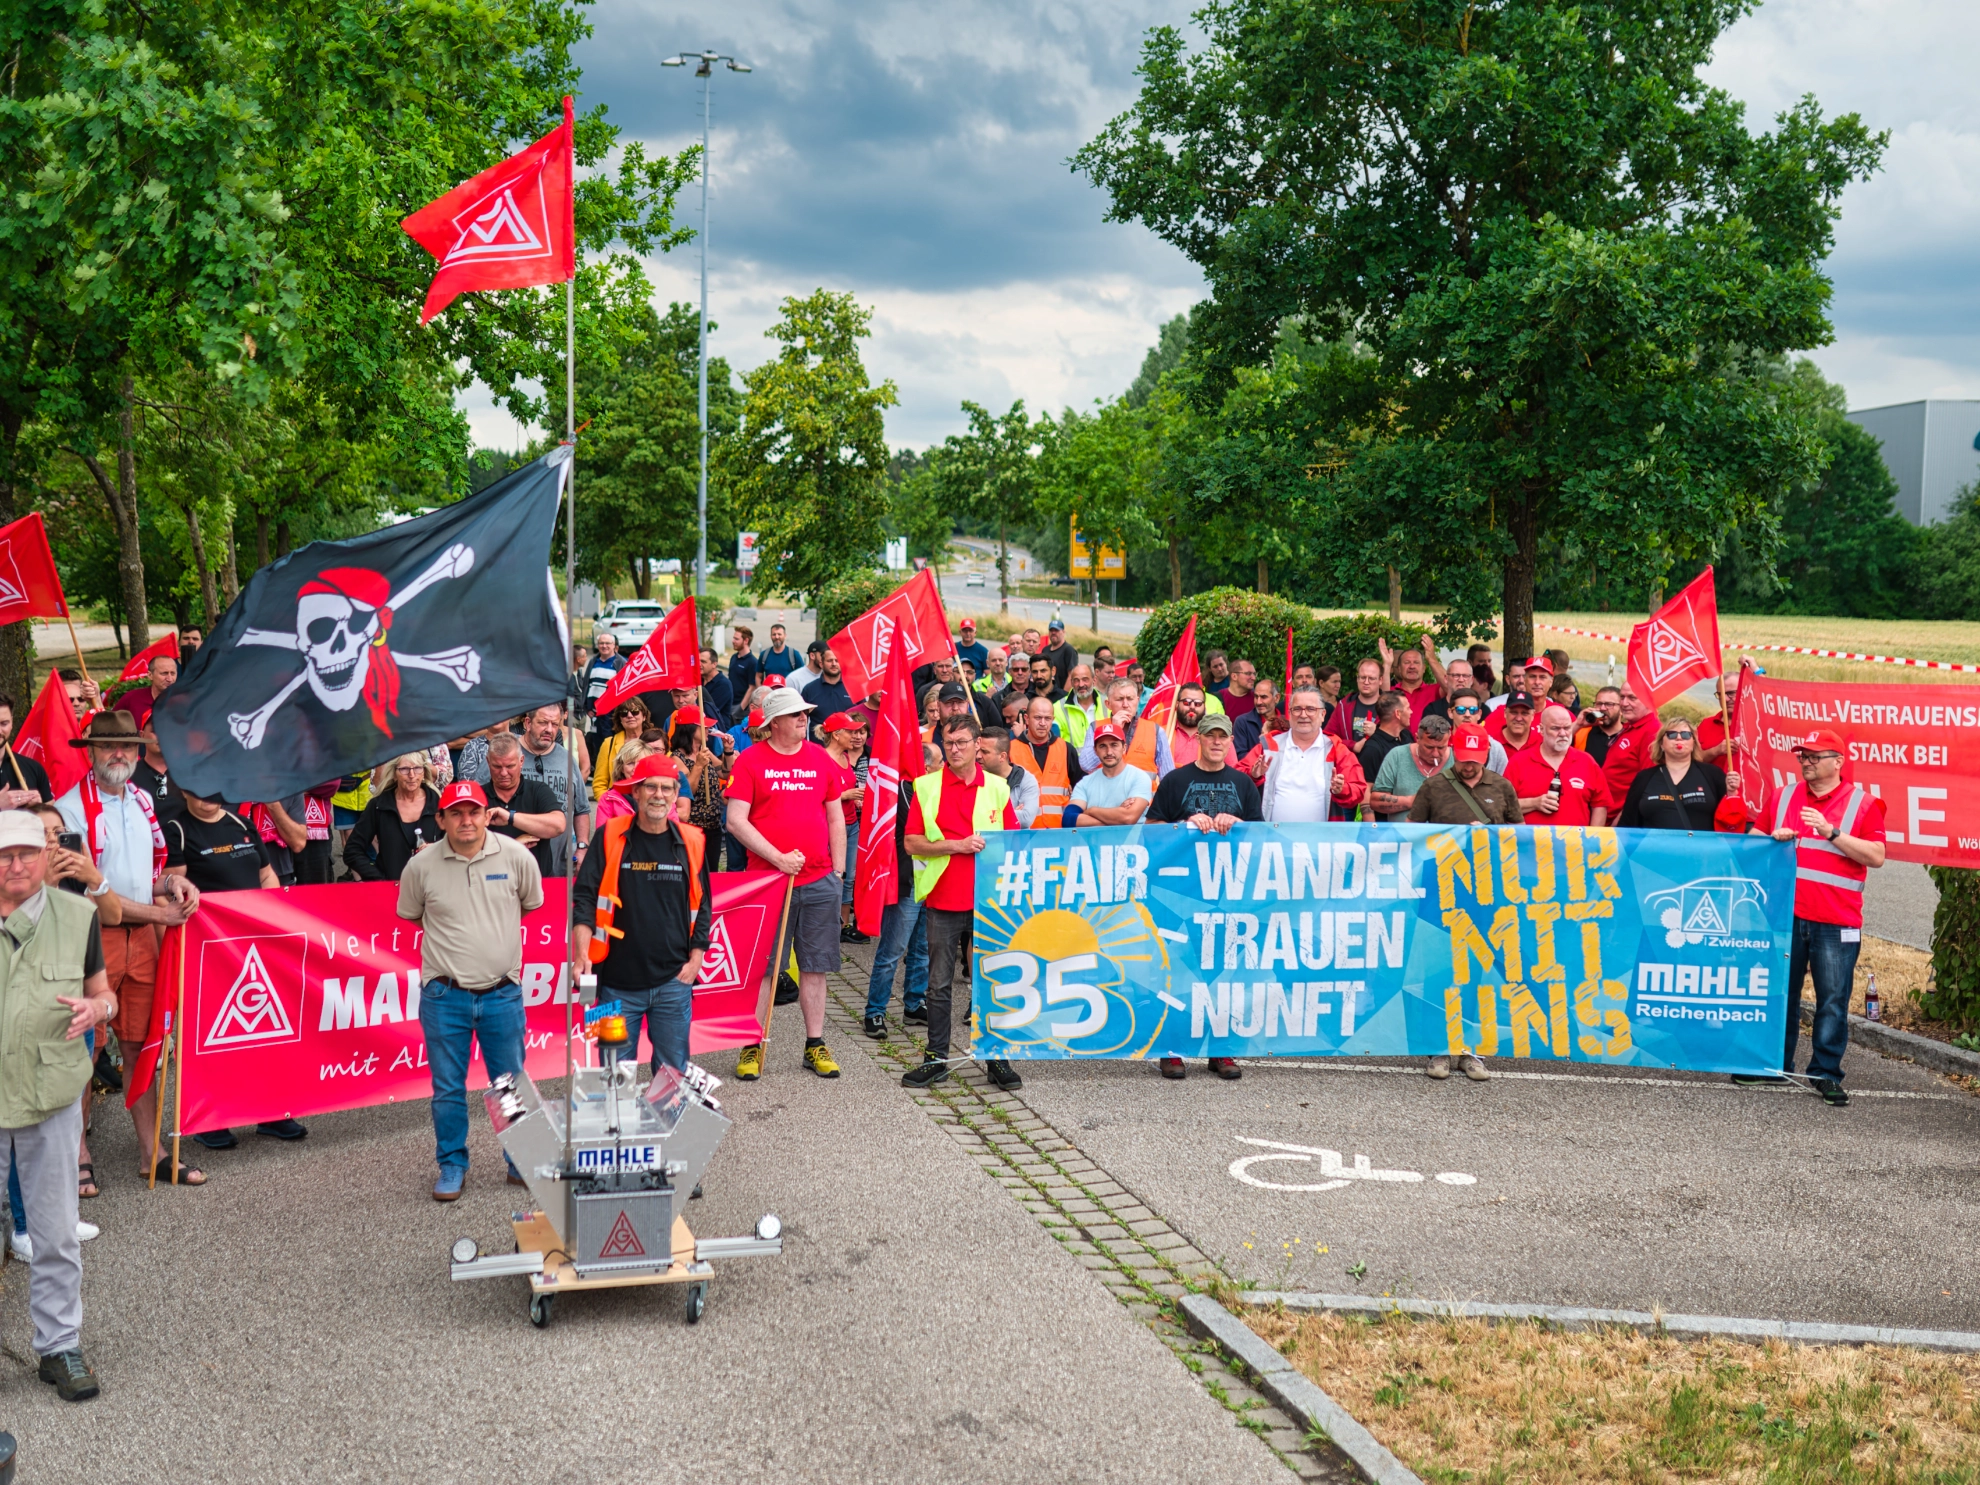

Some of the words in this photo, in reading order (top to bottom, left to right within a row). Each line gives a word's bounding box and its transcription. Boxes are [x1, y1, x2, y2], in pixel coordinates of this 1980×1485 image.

[1762, 692, 1776, 716] IG
[1776, 695, 1980, 727] METALL-VERTRAUENS
[1848, 742, 1909, 764] STARK
[1914, 745, 1948, 766] BEI
[765, 769, 790, 779] More
[792, 768, 817, 778] Than
[771, 781, 780, 791] A
[782, 781, 813, 791] Hero...
[631, 862, 658, 871] ZUKUNFT
[647, 873, 682, 881] SCHWARZ
[995, 843, 1150, 906] #FAIR
[1426, 826, 1623, 910] NUR
[1442, 899, 1614, 986] MIT
[1708, 936, 1770, 949] Zwickau
[1638, 962, 1769, 997] MAHLE
[981, 950, 1110, 1038] 35
[1444, 979, 1633, 1058] UNS
[1636, 1003, 1767, 1023] Reichenbach
[319, 1051, 380, 1081] mit
[578, 1146, 655, 1168] MAHLE
